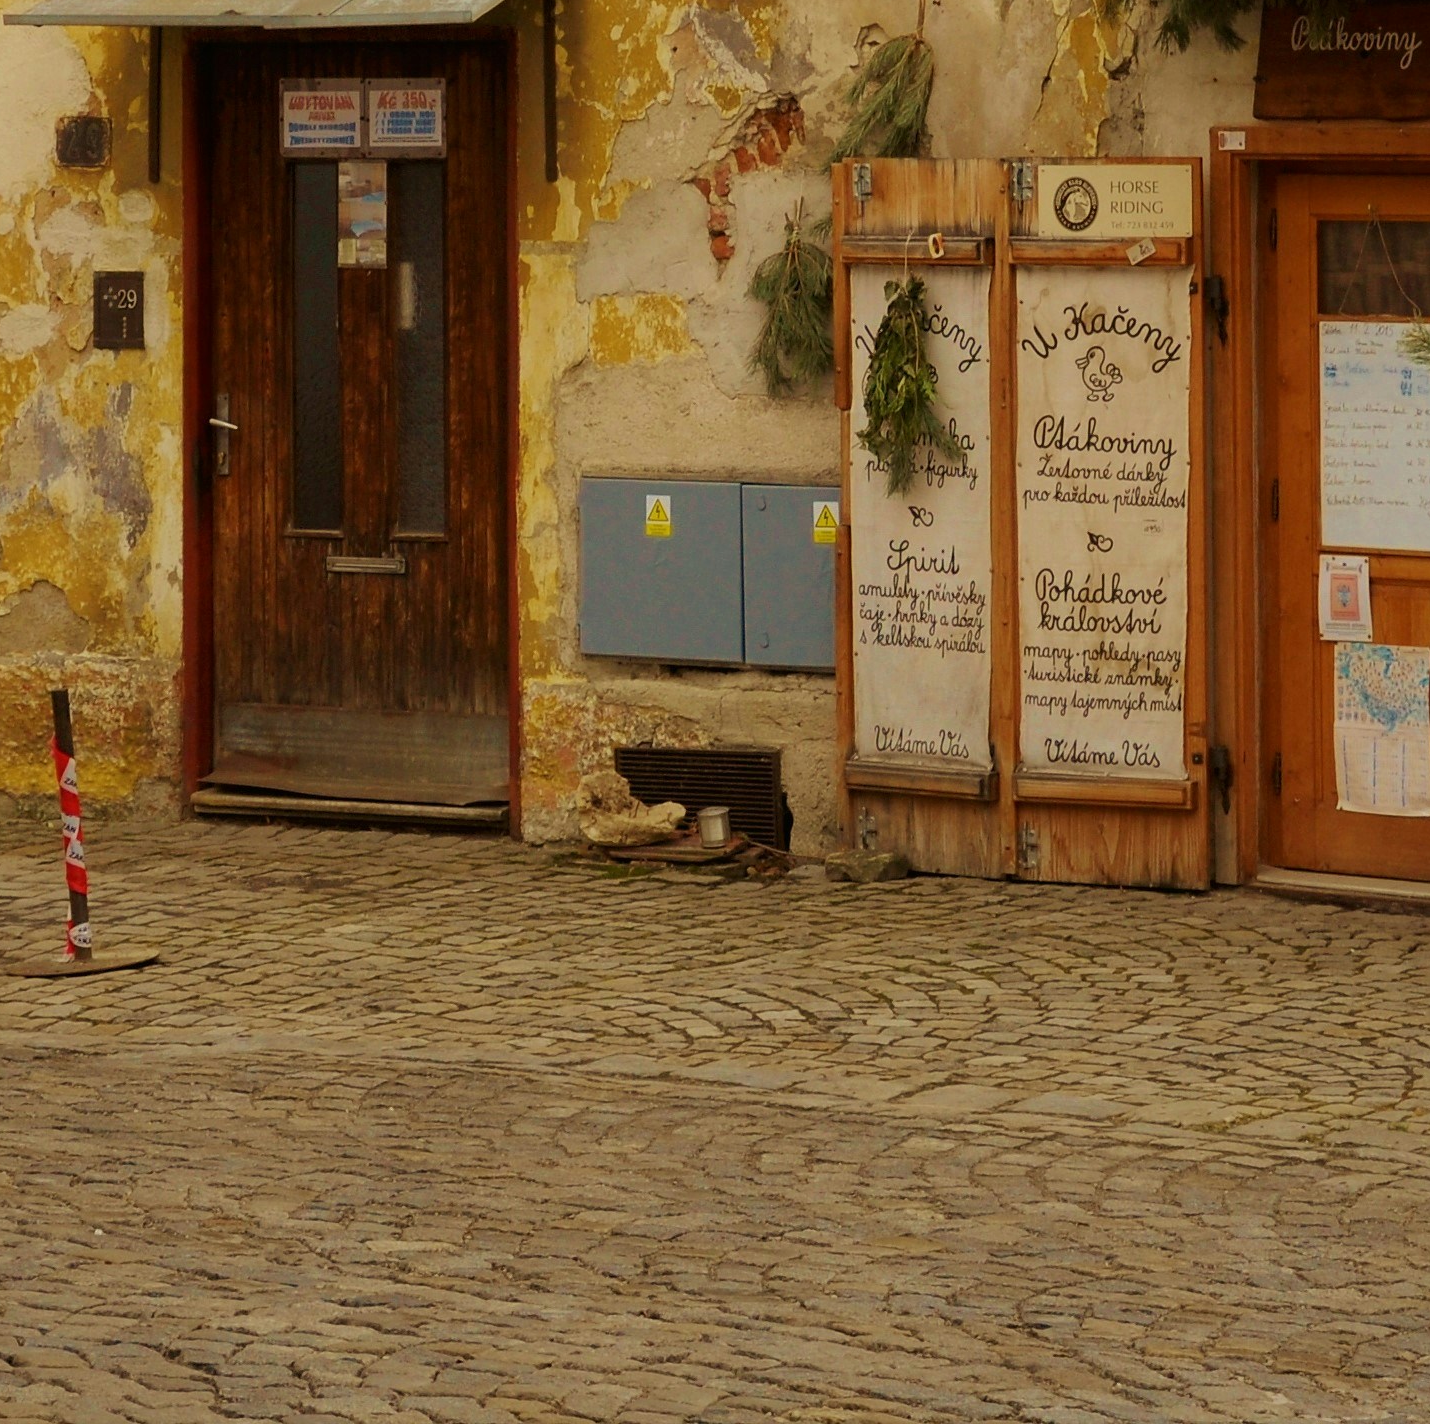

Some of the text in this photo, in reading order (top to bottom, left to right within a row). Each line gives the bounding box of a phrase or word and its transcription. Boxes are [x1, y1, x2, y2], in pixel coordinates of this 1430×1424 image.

[1109, 180, 1159, 193] HORSE
[1110, 200, 1165, 214] RIDING
[117, 289, 137, 309] 29
[1021, 302, 1182, 374] U Kačeny
[1033, 415, 1177, 471] Ptákoviny
[1036, 453, 1168, 495] Žertovné dárky
[1023, 482, 1187, 514] pro každou příležitost
[887, 539, 960, 584] Spirit
[858, 573, 986, 616] amulety přívěsky
[1035, 567, 1167, 605] Pohádkové
[859, 603, 886, 632] čaje
[940, 615, 949, 626] a
[951, 605, 984, 640] dózy
[1037, 601, 1162, 636] království
[859, 629, 867, 645] s
[933, 629, 986, 659] spirálou
[1023, 640, 1182, 672] mapy pohledy pasy
[1024, 689, 1182, 720] mapy tajemných míst
[874, 725, 969, 759] Vítáme Vás
[1044, 738, 1161, 768] Vítáme Vás
